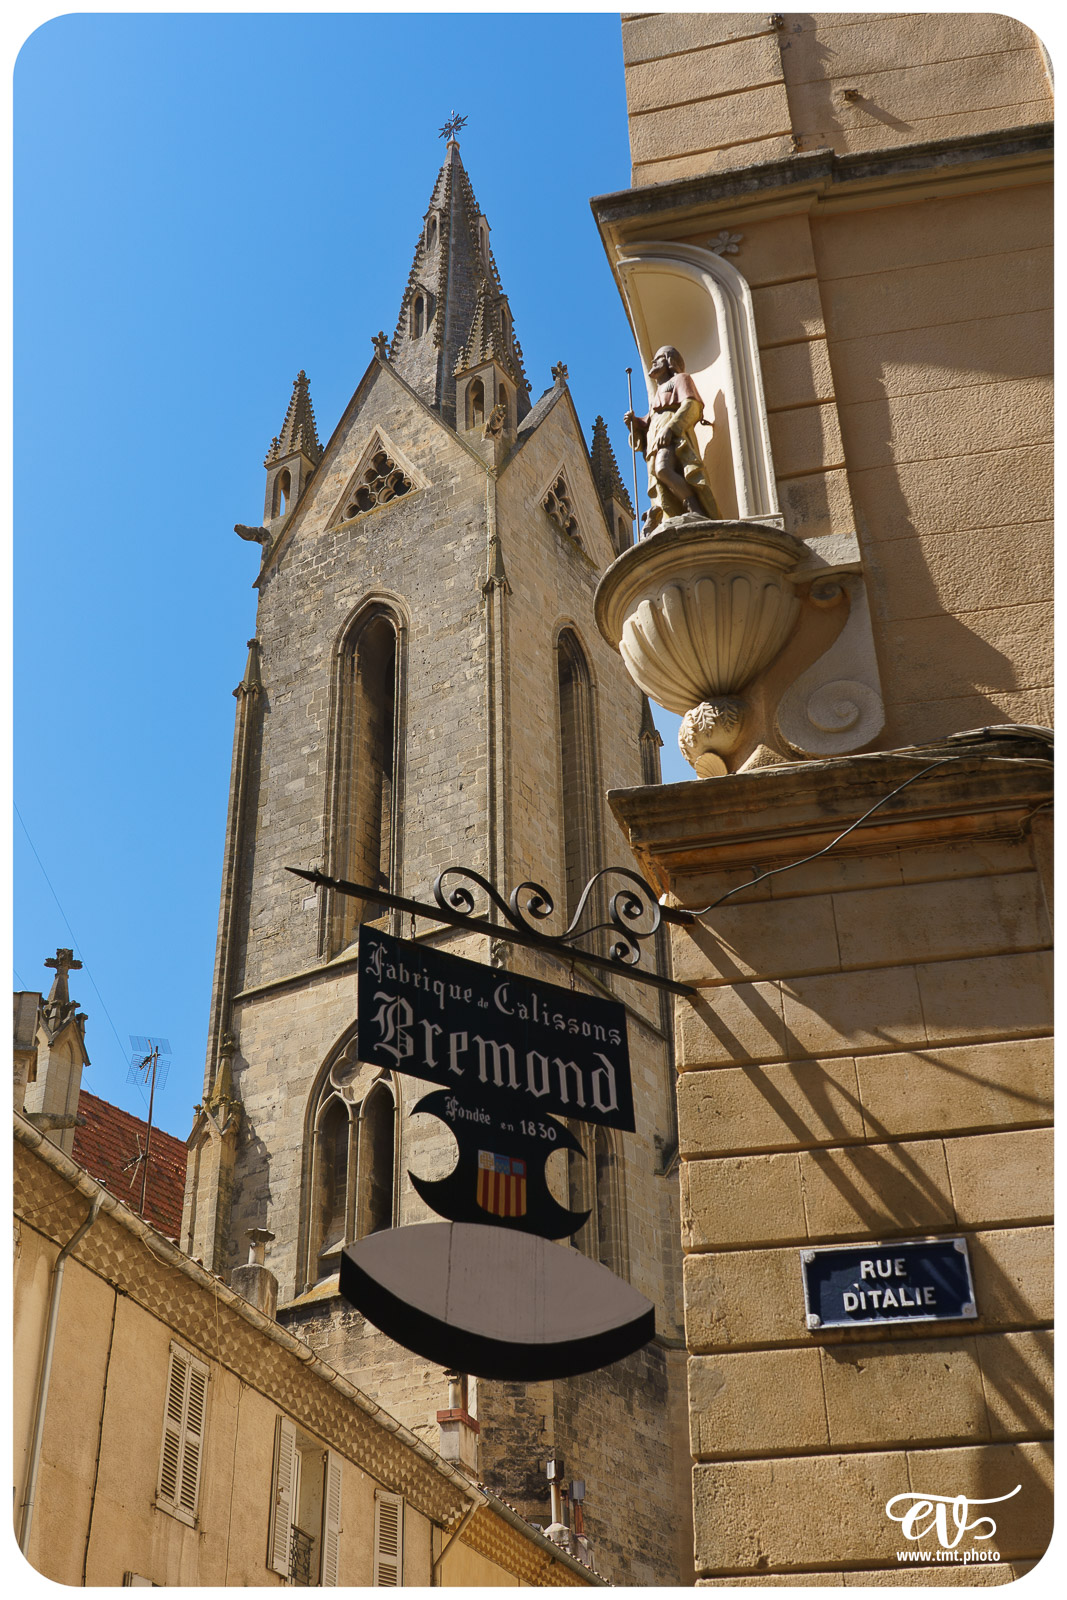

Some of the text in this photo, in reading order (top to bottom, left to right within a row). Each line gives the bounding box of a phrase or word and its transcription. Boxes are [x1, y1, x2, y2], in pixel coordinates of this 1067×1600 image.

[365, 941, 622, 1046] Fabrique de Calissons
[370, 991, 619, 1114] Bremond
[444, 1096, 557, 1141] Fondée en 1830
[860, 1258, 907, 1279] RUE
[842, 1283, 937, 1312] D'ITALIE
